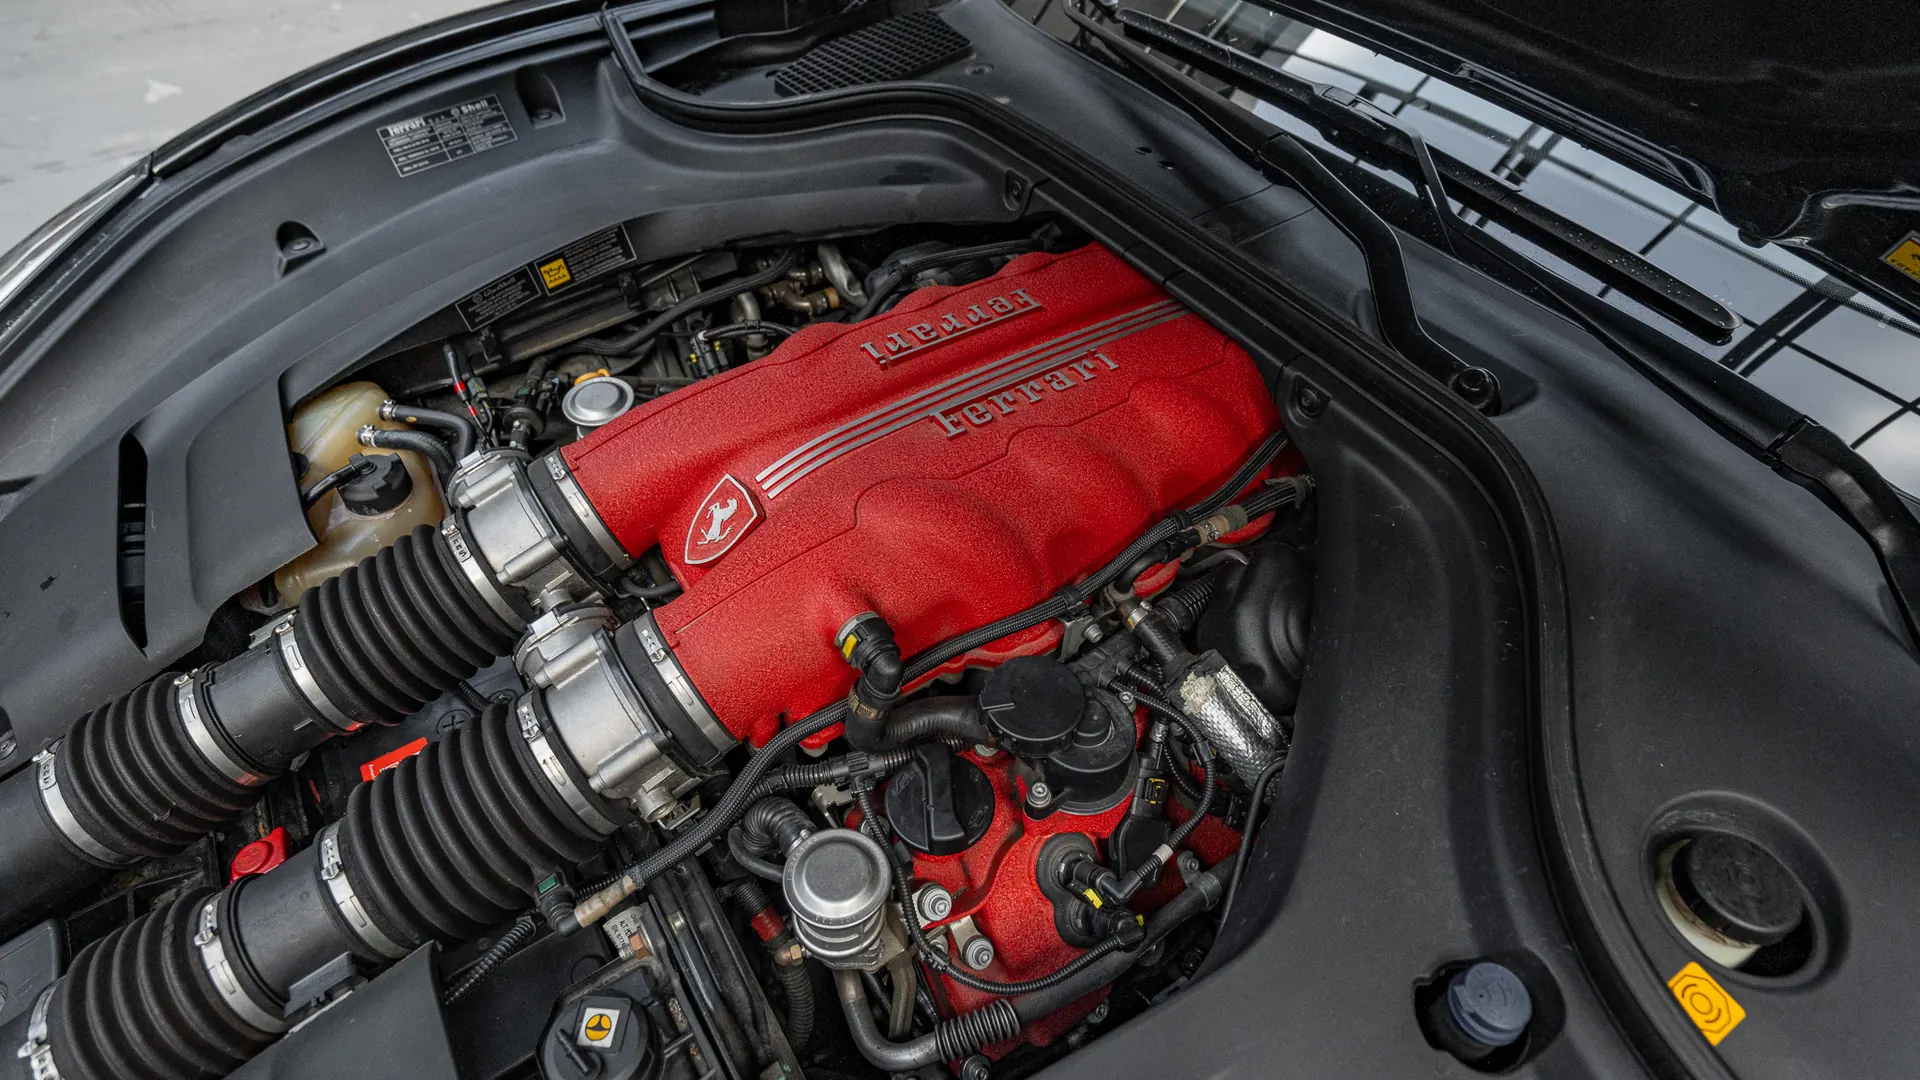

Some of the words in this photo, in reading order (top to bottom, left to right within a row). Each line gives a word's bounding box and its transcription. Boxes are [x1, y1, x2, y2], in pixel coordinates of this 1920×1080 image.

[387, 116, 426, 136] Ferrari
[460, 99, 489, 114] Shell
[860, 287, 1042, 367] Ferrari
[928, 348, 1120, 439] Ferrari
